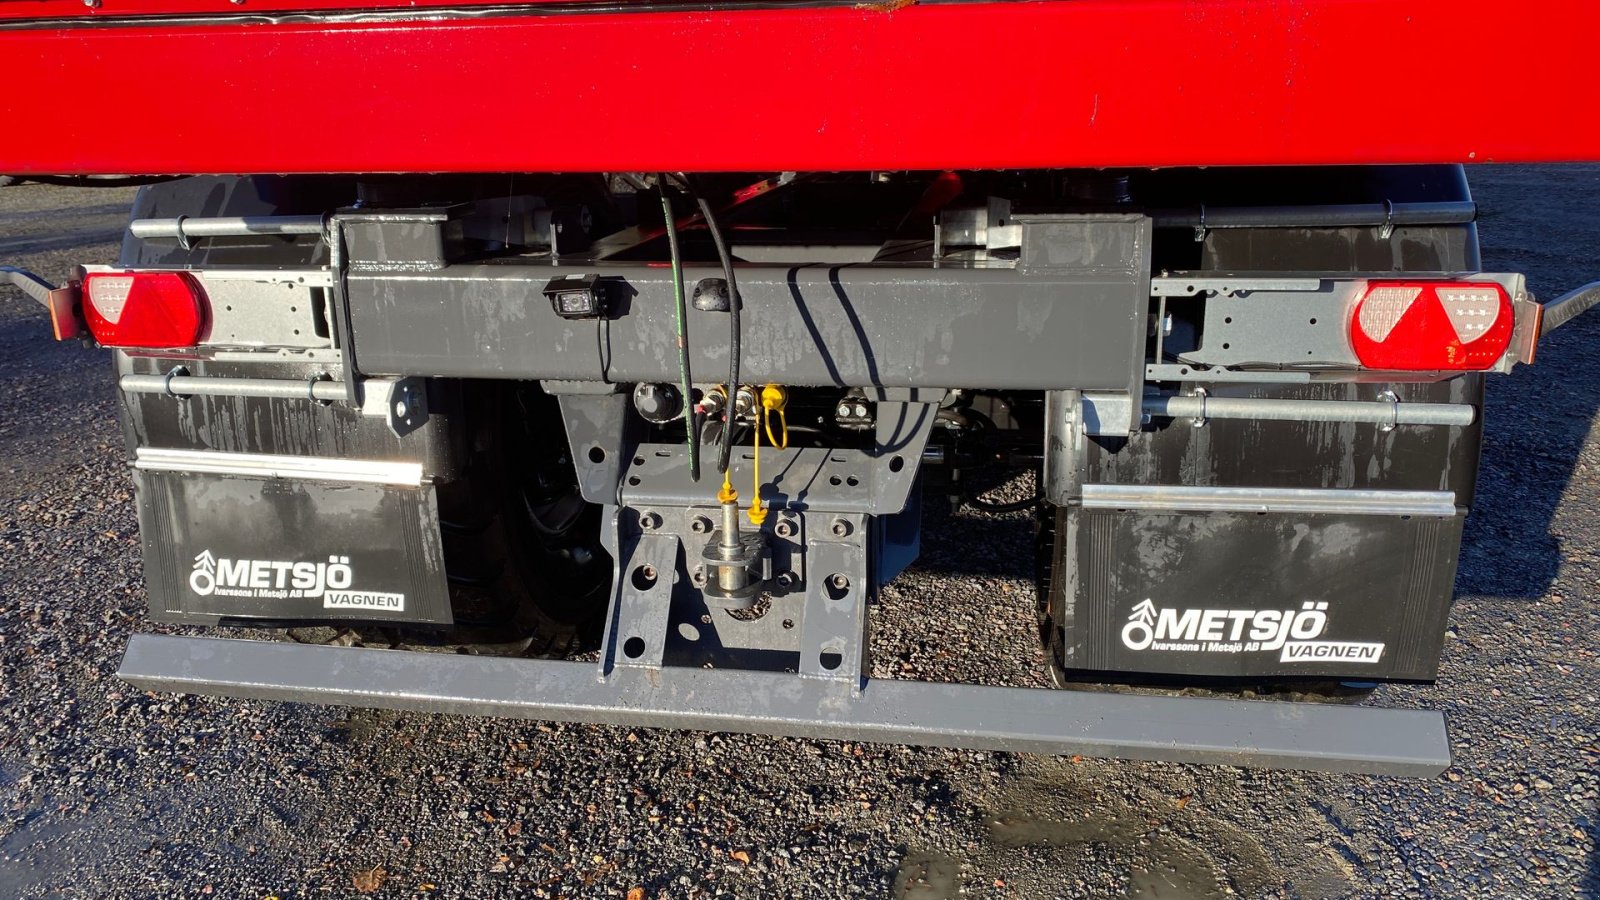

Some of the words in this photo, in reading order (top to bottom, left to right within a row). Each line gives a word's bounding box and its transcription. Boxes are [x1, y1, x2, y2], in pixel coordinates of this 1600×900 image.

[216, 555, 352, 597] METSJÖ
[289, 589, 303, 598] AB
[329, 593, 400, 607] VAGNEN
[1153, 601, 1329, 651] METSJÖ
[1153, 642, 1200, 651] Ivarssons
[1208, 642, 1242, 654] Metsjö
[1243, 642, 1260, 652] AB
[1288, 645, 1377, 659] VAGNEN
